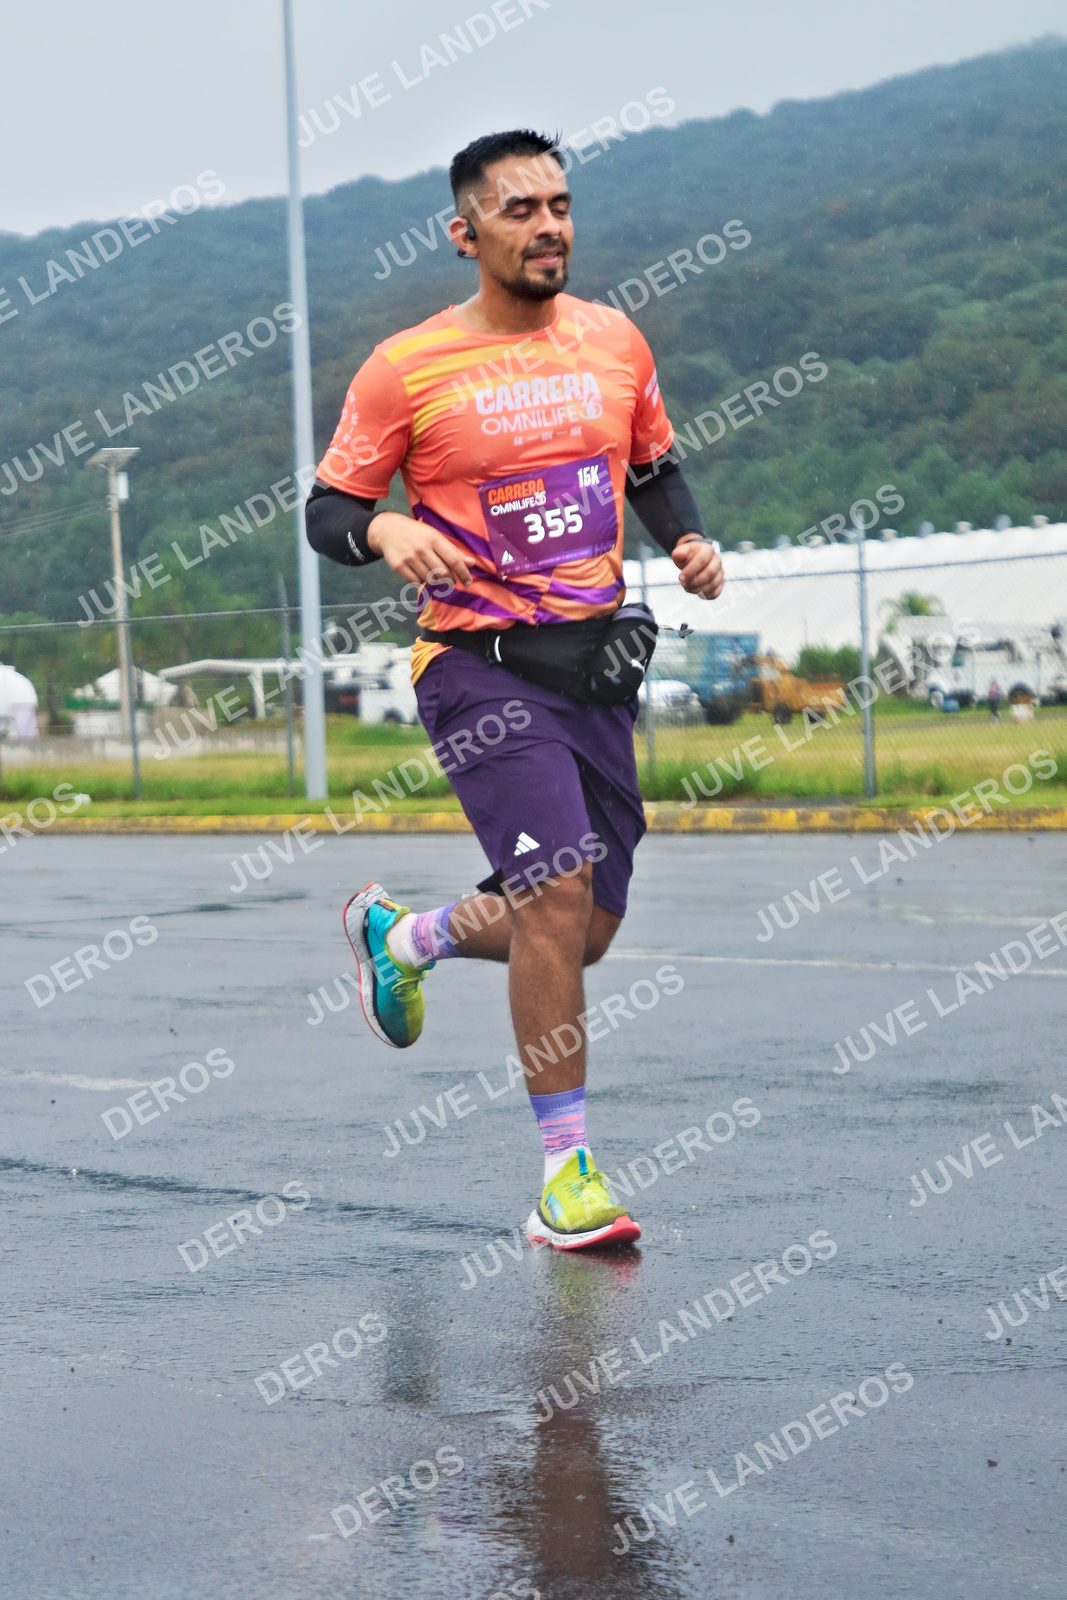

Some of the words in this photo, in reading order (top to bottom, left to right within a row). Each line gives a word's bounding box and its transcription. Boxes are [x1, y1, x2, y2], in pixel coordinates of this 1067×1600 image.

[475, 373, 602, 415] CARRERA
[481, 404, 578, 435] OMNILIFE
[577, 464, 600, 488] 16K
[488, 478, 545, 505] CARRERA
[490, 496, 535, 516] OMNILIFE
[523, 504, 583, 544] 355
